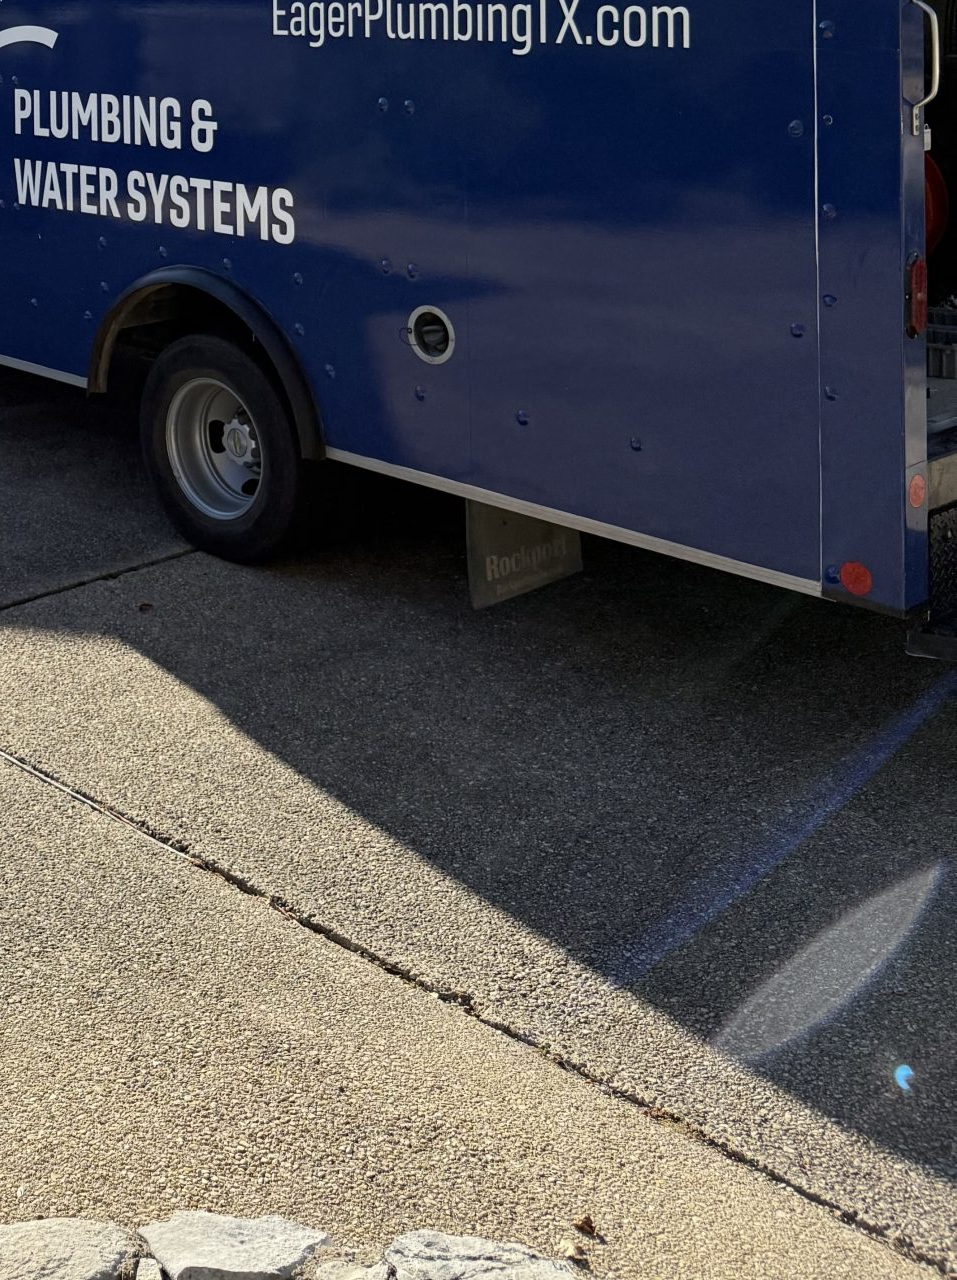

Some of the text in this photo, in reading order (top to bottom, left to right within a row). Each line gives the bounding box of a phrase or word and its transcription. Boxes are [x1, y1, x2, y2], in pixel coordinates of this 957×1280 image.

[13, 88, 218, 153] PLUMBING &
[13, 157, 296, 246] WATER SYSTEMS
